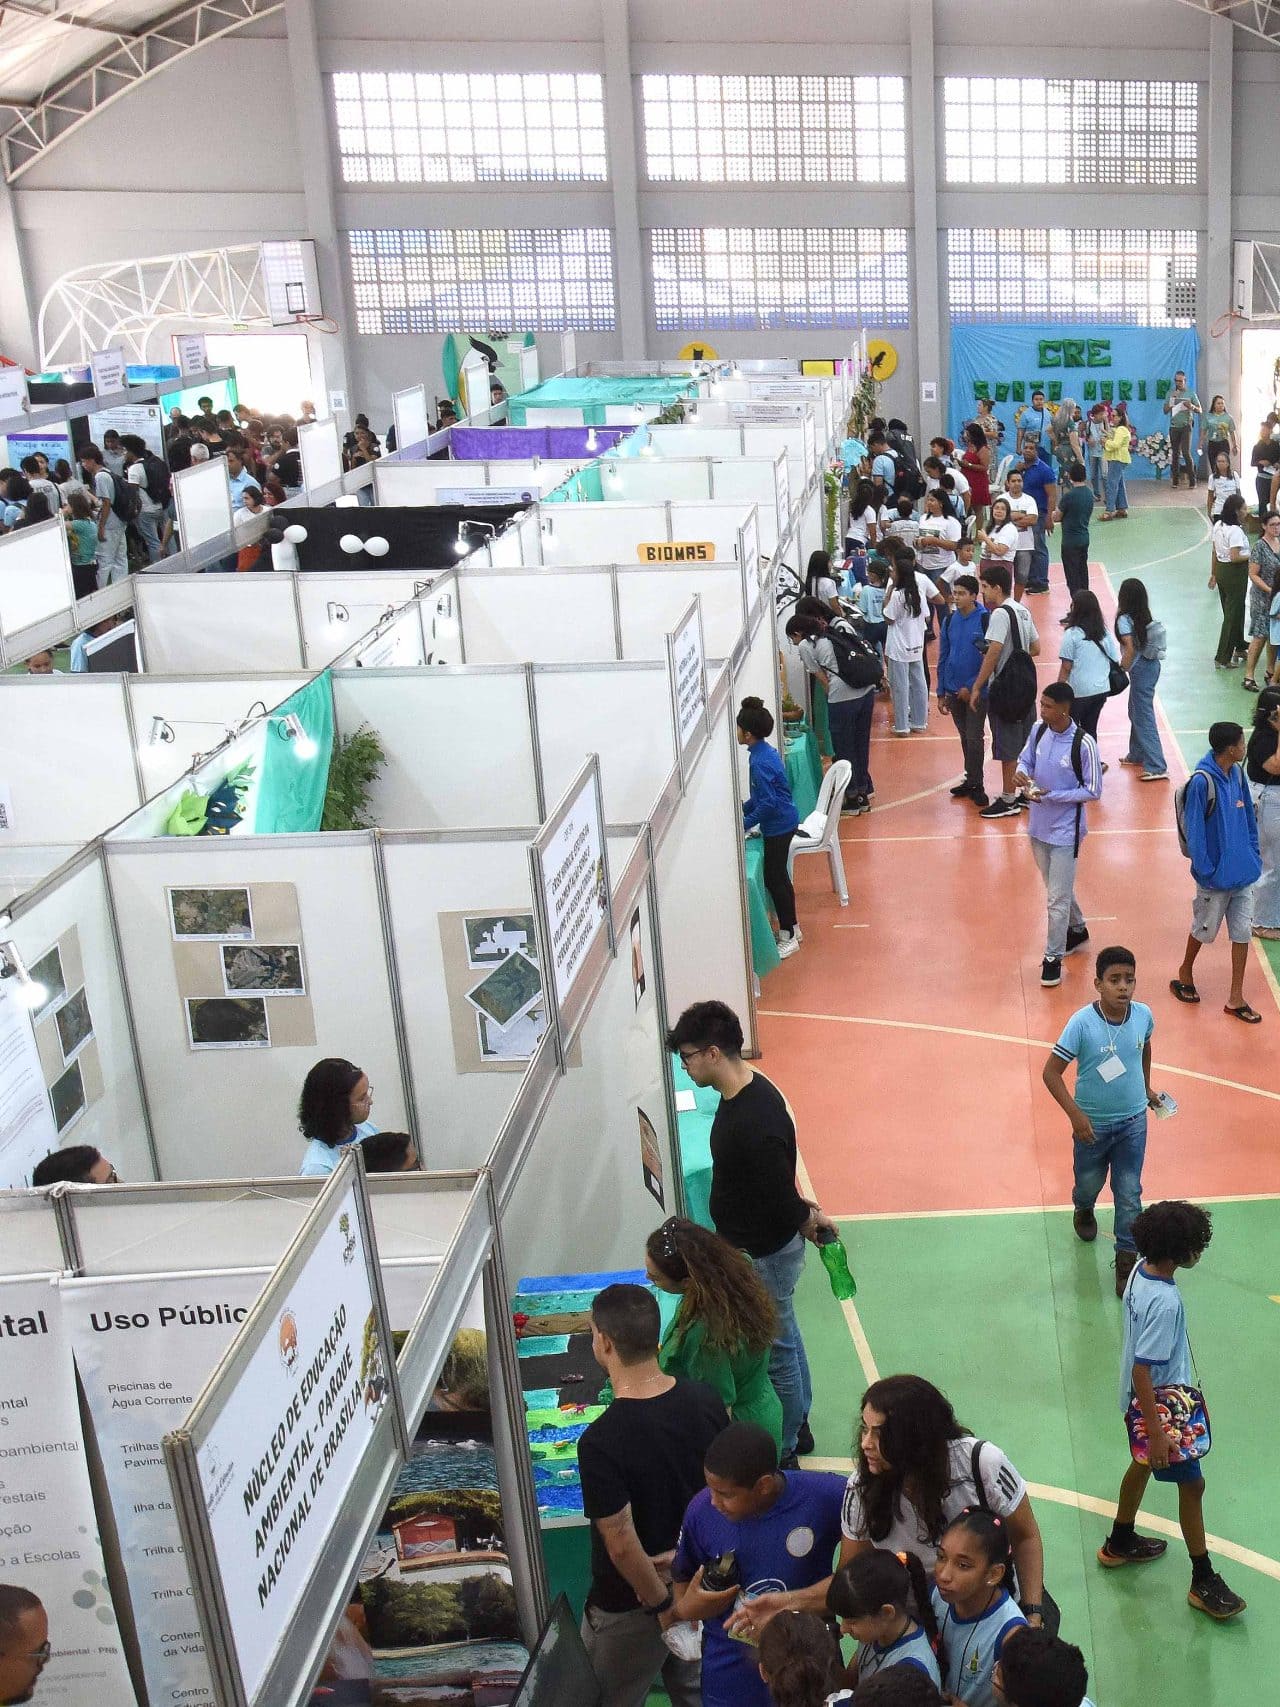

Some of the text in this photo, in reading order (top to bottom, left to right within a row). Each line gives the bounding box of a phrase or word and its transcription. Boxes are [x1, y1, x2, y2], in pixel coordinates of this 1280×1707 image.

[1038, 338, 1112, 368] CRE
[646, 545, 707, 561] BIOMAS
[91, 1311, 150, 1332] Uso
[108, 1380, 172, 1393] Piscinas de
[112, 1394, 193, 1410] Água Corrente
[243, 1303, 347, 1516] NÚCLEO DE EDUCAÇÃO
[121, 1443, 160, 1454] Trilhas
[254, 1430, 315, 1558] AMBIENTAL
[318, 1343, 353, 1428] PARQUE
[257, 1379, 363, 1609] NACIONAL DE BRASÍLIA
[133, 1502, 172, 1513] Ilha da
[10, 1550, 81, 1565] a Escolas
[142, 1545, 175, 1557] Trilha
[151, 1589, 183, 1600] Trilha
[163, 1644, 205, 1657] da Vida
[171, 1687, 209, 1699] Centro
